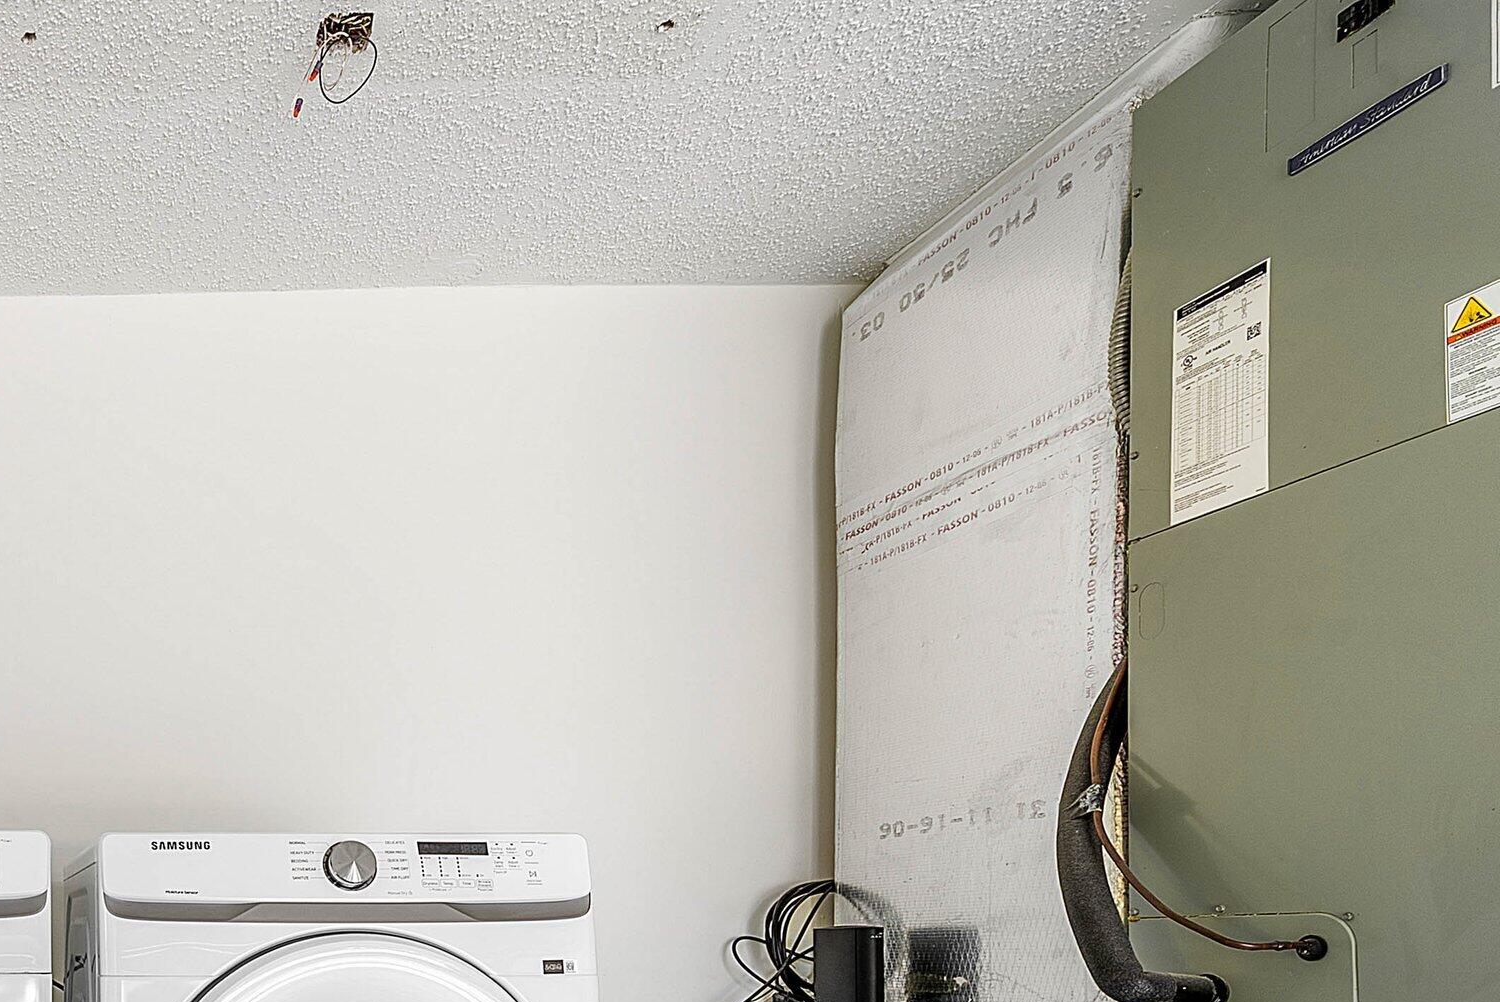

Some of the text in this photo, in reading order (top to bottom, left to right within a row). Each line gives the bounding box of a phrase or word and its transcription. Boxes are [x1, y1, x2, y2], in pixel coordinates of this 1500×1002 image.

[884, 477, 923, 504] FASSON
[929, 461, 954, 481] 0810
[844, 516, 880, 541] FASSON
[936, 508, 980, 537] FASSON
[987, 493, 1016, 512] 0810
[1089, 507, 1100, 569] FASSON
[150, 841, 211, 851] SAMSUNG
